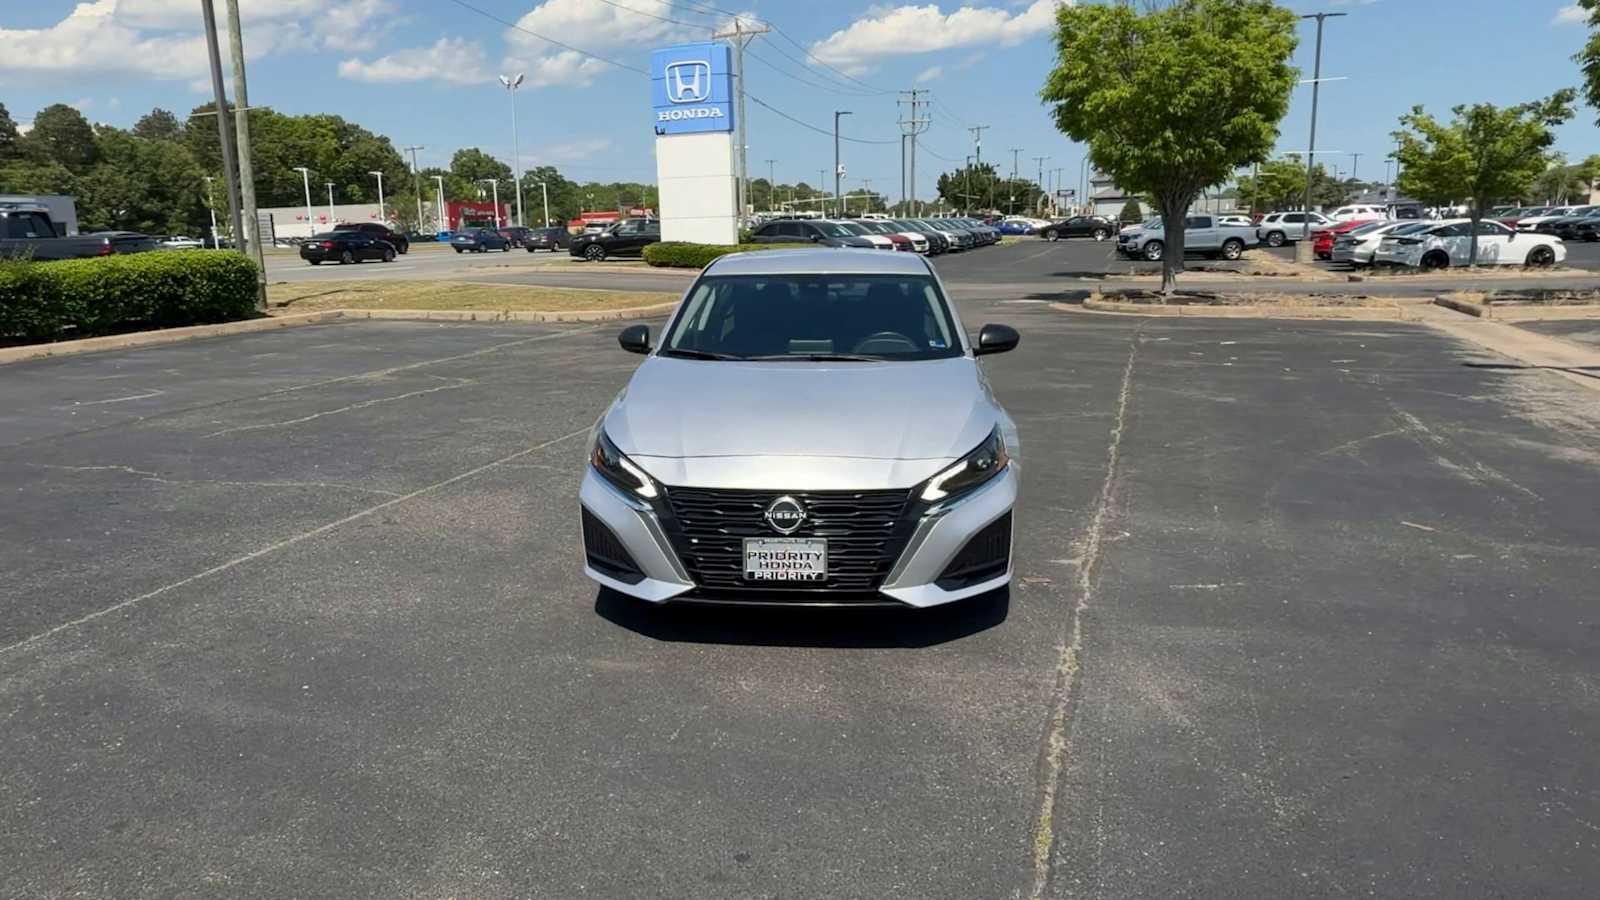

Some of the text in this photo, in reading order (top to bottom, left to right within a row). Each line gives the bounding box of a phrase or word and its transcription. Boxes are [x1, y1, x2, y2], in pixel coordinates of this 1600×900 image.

[657, 107, 724, 121] HONDA
[764, 511, 807, 520] NISSAN
[747, 551, 822, 561] PRIORITY
[759, 561, 813, 570] HONDA
[754, 571, 818, 580] PRIORITY
